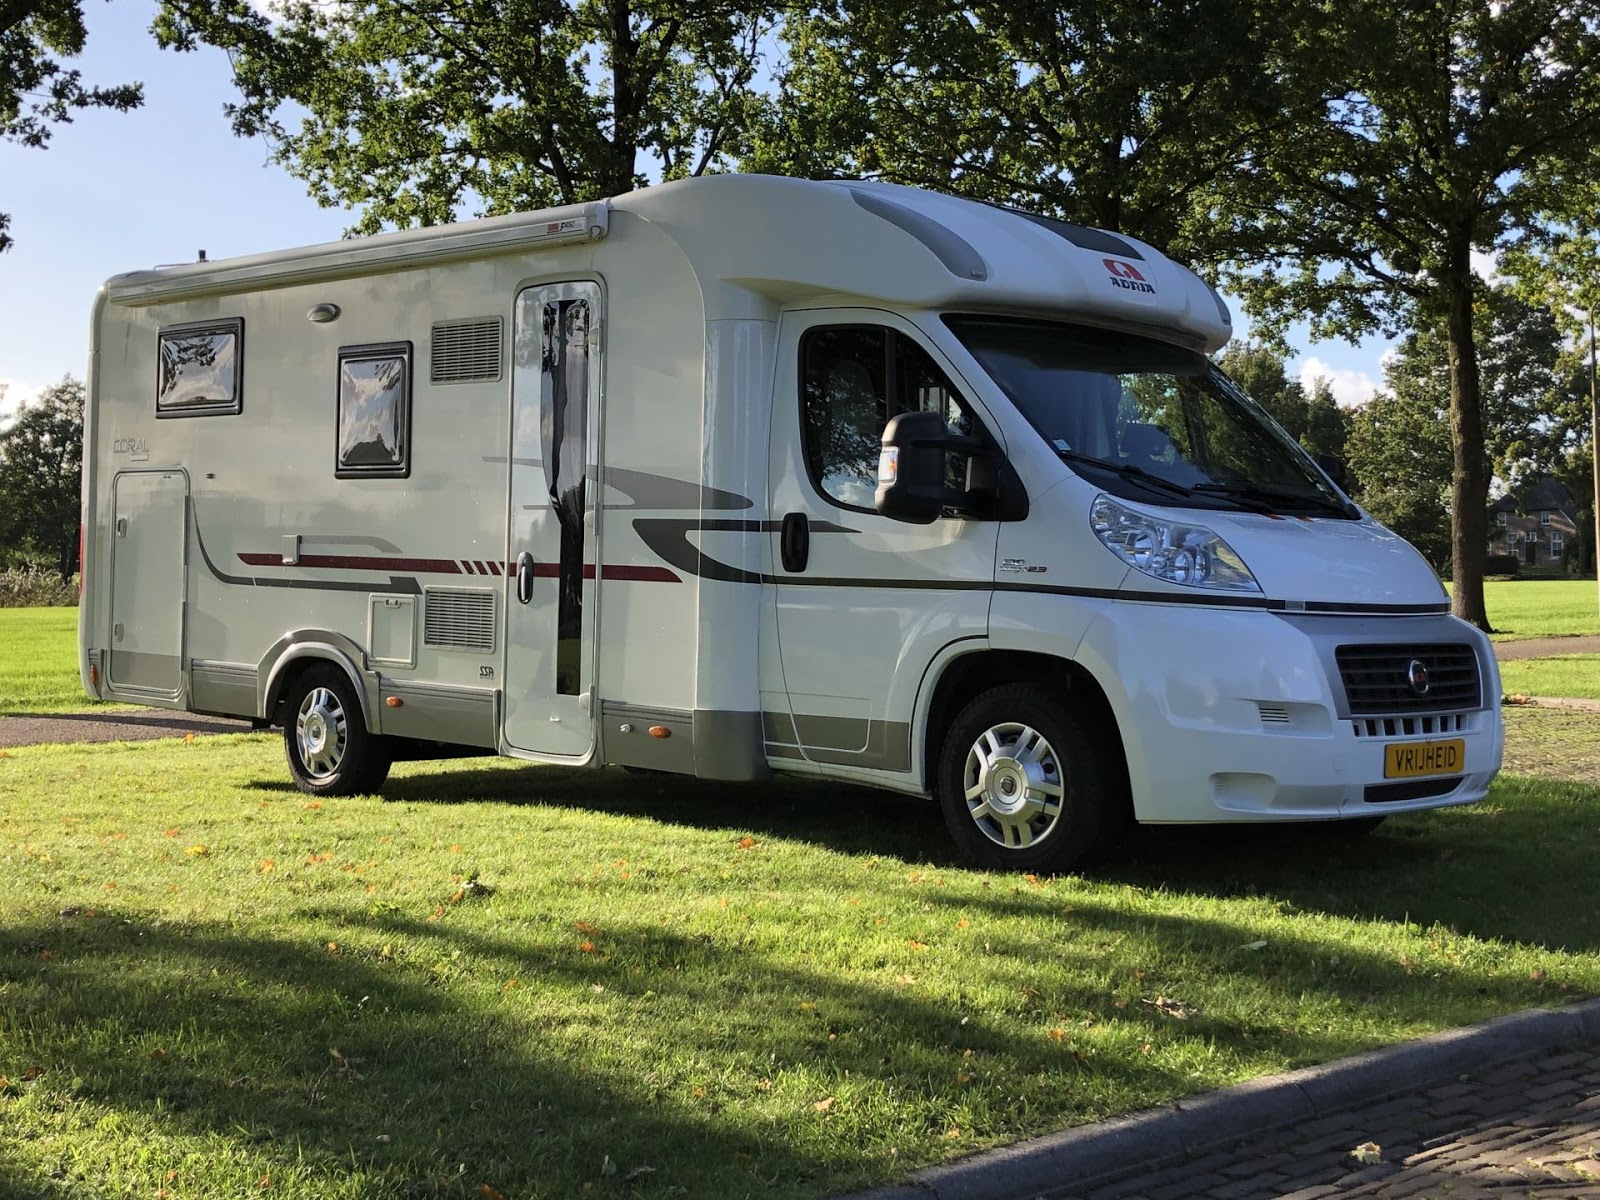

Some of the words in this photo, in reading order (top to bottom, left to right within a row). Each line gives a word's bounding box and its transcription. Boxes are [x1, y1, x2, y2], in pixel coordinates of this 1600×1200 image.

[1109, 276, 1156, 294] ADRIA
[113, 439, 150, 453] CORAL
[1395, 745, 1457, 771] VRIJHEID
